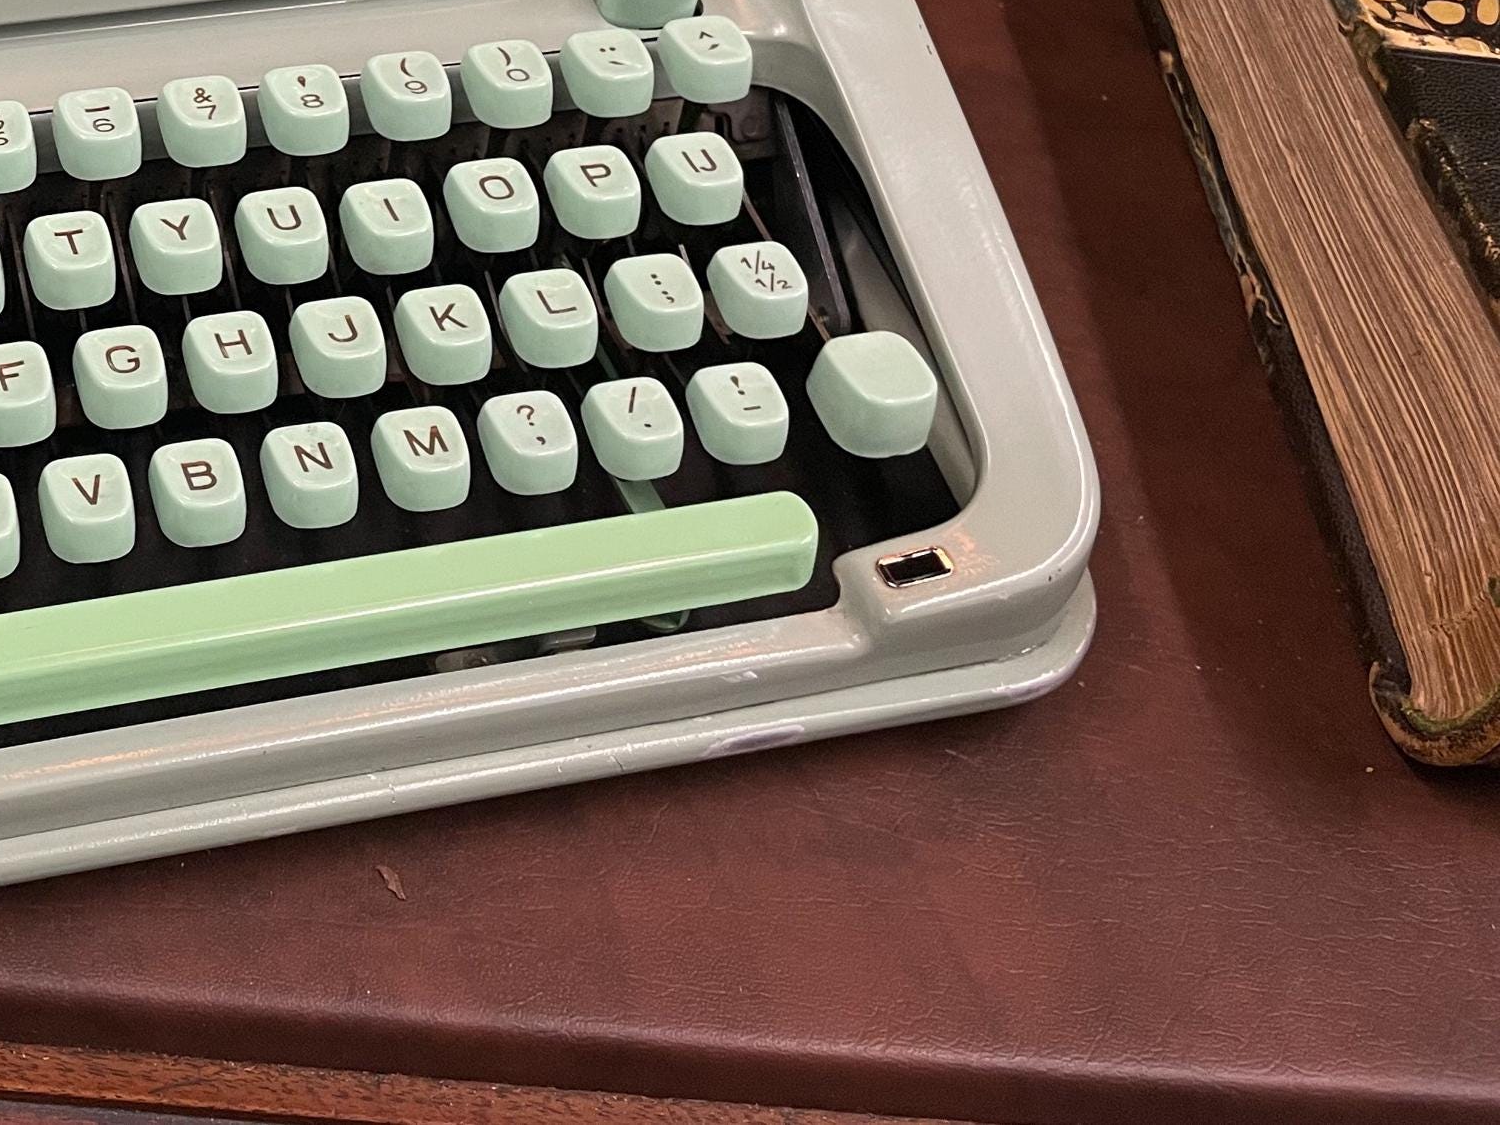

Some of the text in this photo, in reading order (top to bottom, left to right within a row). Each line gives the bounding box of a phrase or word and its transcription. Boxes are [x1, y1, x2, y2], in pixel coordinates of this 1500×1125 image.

[404, 80, 428, 95] 9
[506, 68, 530, 82] 0
[193, 87, 213, 103] &
[300, 94, 325, 109] 8
[196, 104, 217, 120] 7
[92, 118, 115, 133] 6
[478, 175, 515, 200] O
[579, 163, 612, 188] P
[266, 204, 302, 231] U
[383, 198, 400, 222] I
[160, 215, 190, 241] Y
[54, 228, 84, 255] T
[536, 290, 578, 315] L
[327, 314, 358, 343] J
[429, 303, 468, 332] K
[214, 329, 253, 359] H
[105, 345, 141, 374] G
[516, 404, 535, 427] ?
[403, 425, 449, 457] M
[293, 442, 334, 473] N
[180, 460, 218, 491] B
[71, 474, 101, 506] V
